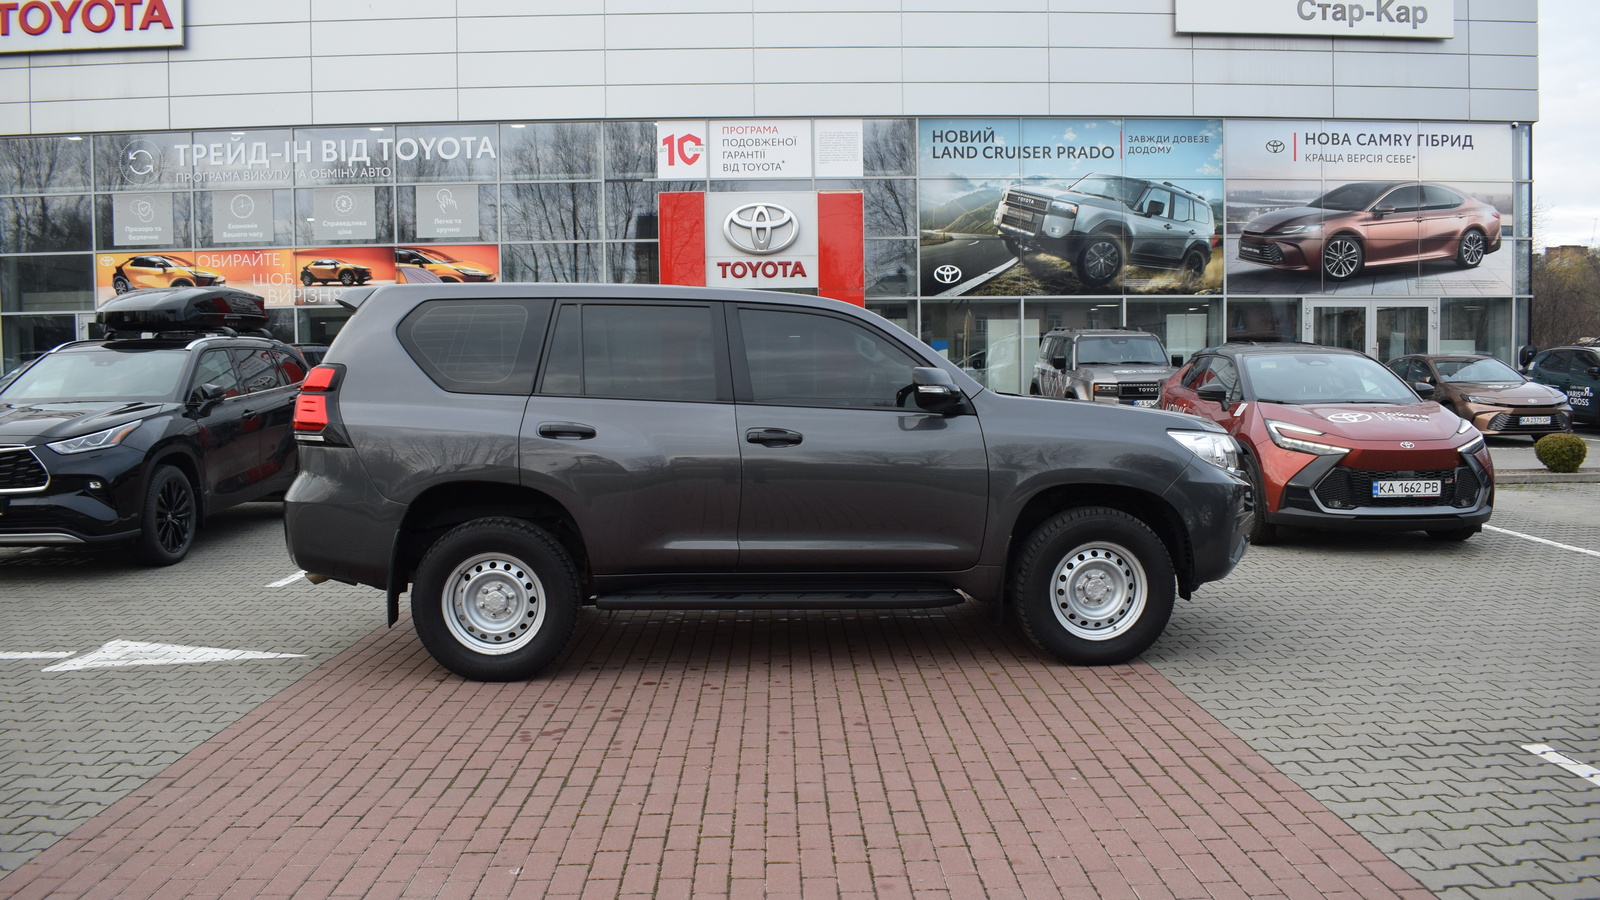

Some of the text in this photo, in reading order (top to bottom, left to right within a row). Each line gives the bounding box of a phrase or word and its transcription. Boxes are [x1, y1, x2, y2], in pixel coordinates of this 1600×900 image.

[0, 0, 174, 36] TOYOTA
[1297, 0, 1428, 29] Стар-Кар
[722, 126, 779, 135] ПРОГРАМА
[932, 127, 995, 143] НОВИЙ
[722, 136, 797, 148] ПОДОВЖЕНОЇ
[1128, 135, 1210, 144] ЗАВЖДИ ДОВЕЗЕ
[1305, 132, 1474, 150] НОВА CAMRY ГІБРИД
[174, 136, 496, 169] ТРЕЙД-ІН ВІД TOYOTA
[722, 148, 766, 159] ГАРАНТІЇ
[932, 145, 1115, 159] LAND CRUISER PRADO
[1128, 146, 1172, 155] ДОДОМУ
[1305, 154, 1344, 164] КРАЩА
[1347, 154, 1383, 163] ВЕРСІЯ
[722, 163, 739, 173] ВІД
[176, 167, 391, 183] ПРОГРАМА ВИКУПУ ТА ОБМІНУ АВТО
[322, 220, 367, 228] Справедлива
[248, 231, 263, 239] часу
[436, 227, 460, 235] зручно
[197, 251, 285, 268] ОБИРАЙТЕ,
[716, 260, 807, 279] TOYOTA
[252, 272, 294, 288] ЩОБ
[1569, 397, 1589, 406] CROSS
[1380, 482, 1438, 493] KA 1662 PB
